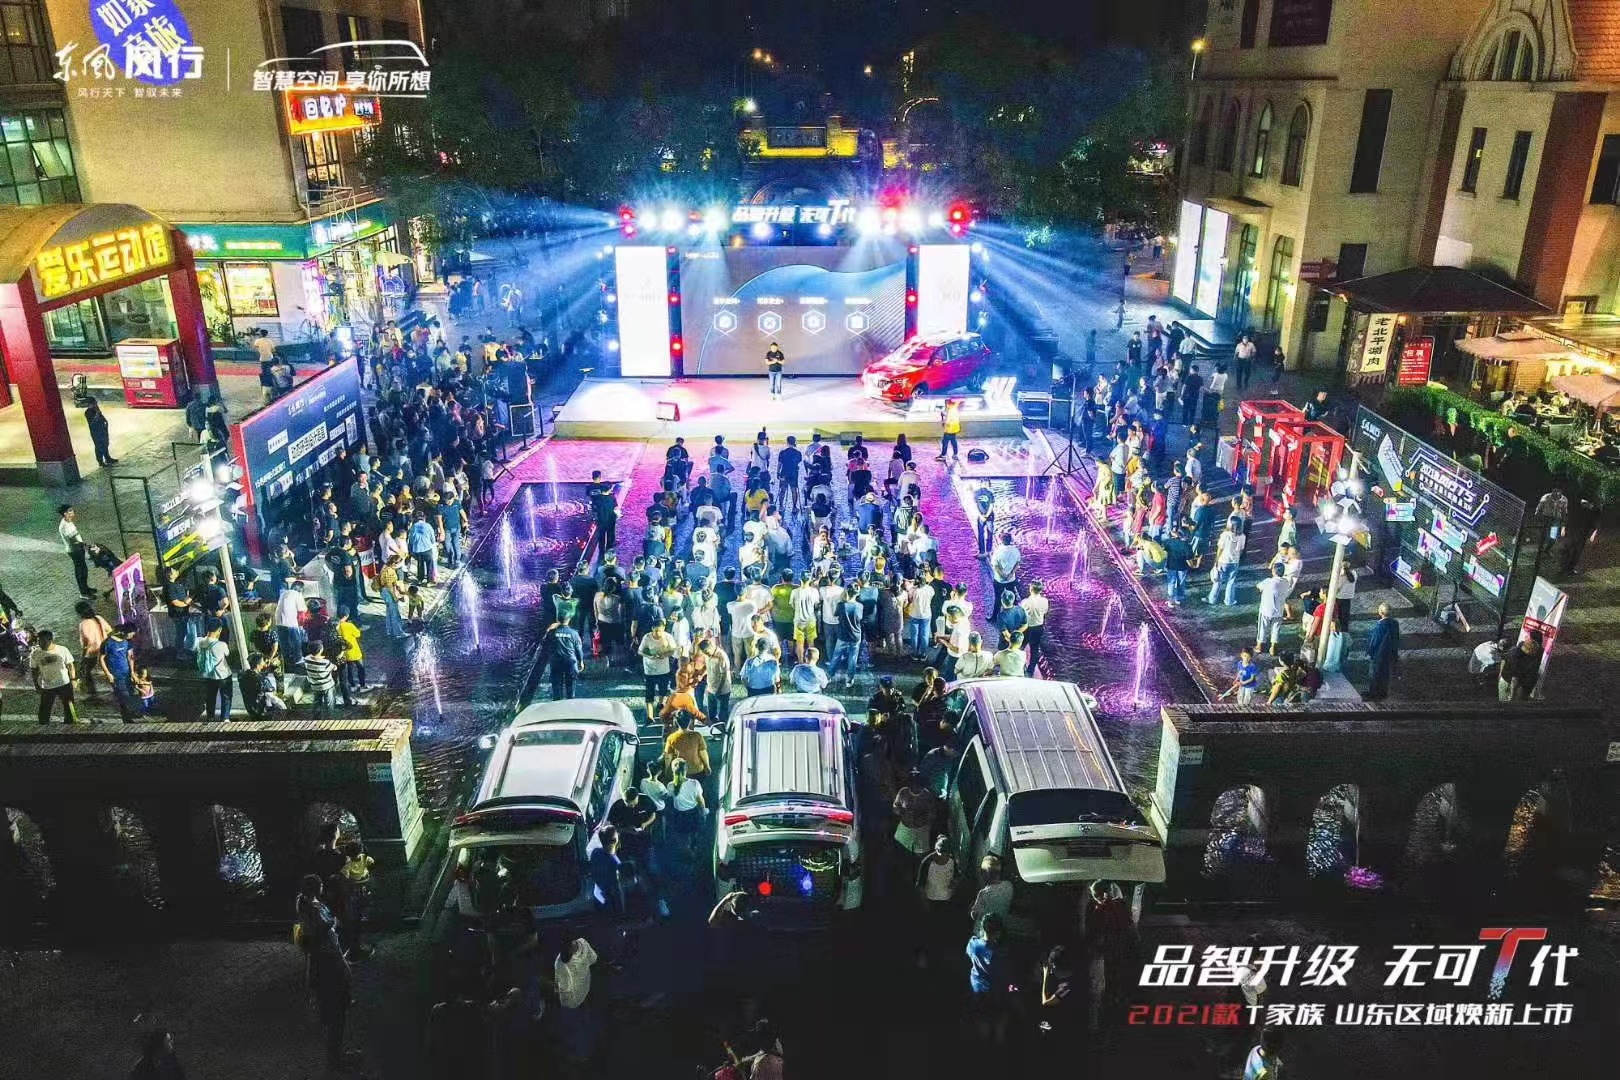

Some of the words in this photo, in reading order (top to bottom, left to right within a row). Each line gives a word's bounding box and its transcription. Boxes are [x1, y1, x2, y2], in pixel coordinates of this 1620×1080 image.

[36, 223, 169, 297] 爱乐运动馆
[1366, 317, 1391, 366] 老北平涮肉
